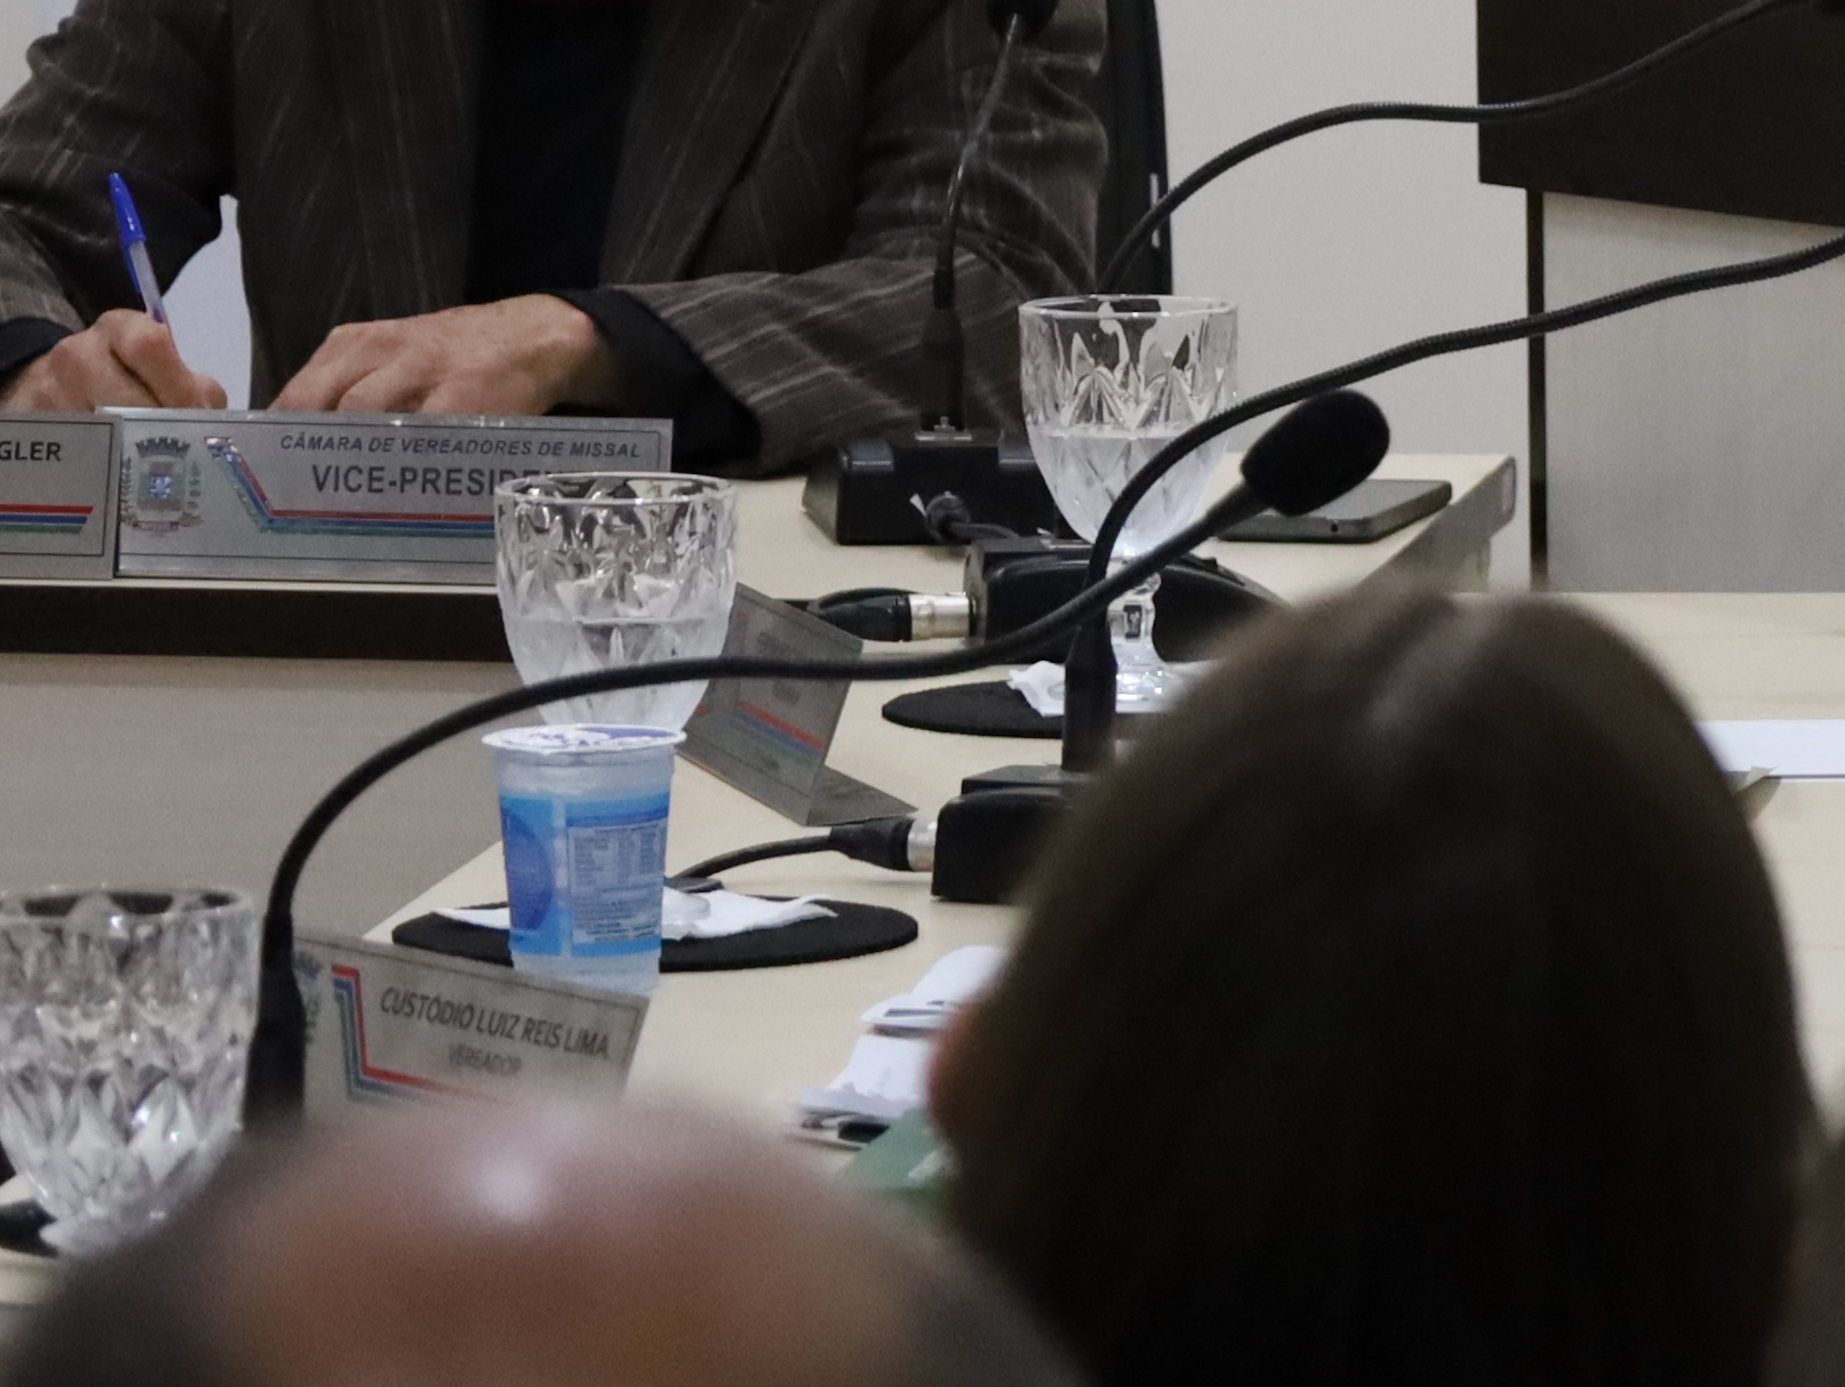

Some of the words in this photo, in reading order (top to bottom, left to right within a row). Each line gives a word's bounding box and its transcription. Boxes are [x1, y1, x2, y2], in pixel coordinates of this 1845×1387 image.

[280, 431, 362, 452] CÂMARA
[368, 436, 396, 453] DE
[401, 437, 532, 456] VEREADORES
[537, 440, 565, 458] DE
[569, 441, 640, 459] MISSAL
[475, 1007, 521, 1041] LUIZ
[520, 1016, 564, 1049] REIS
[563, 1026, 610, 1059] LIMA
